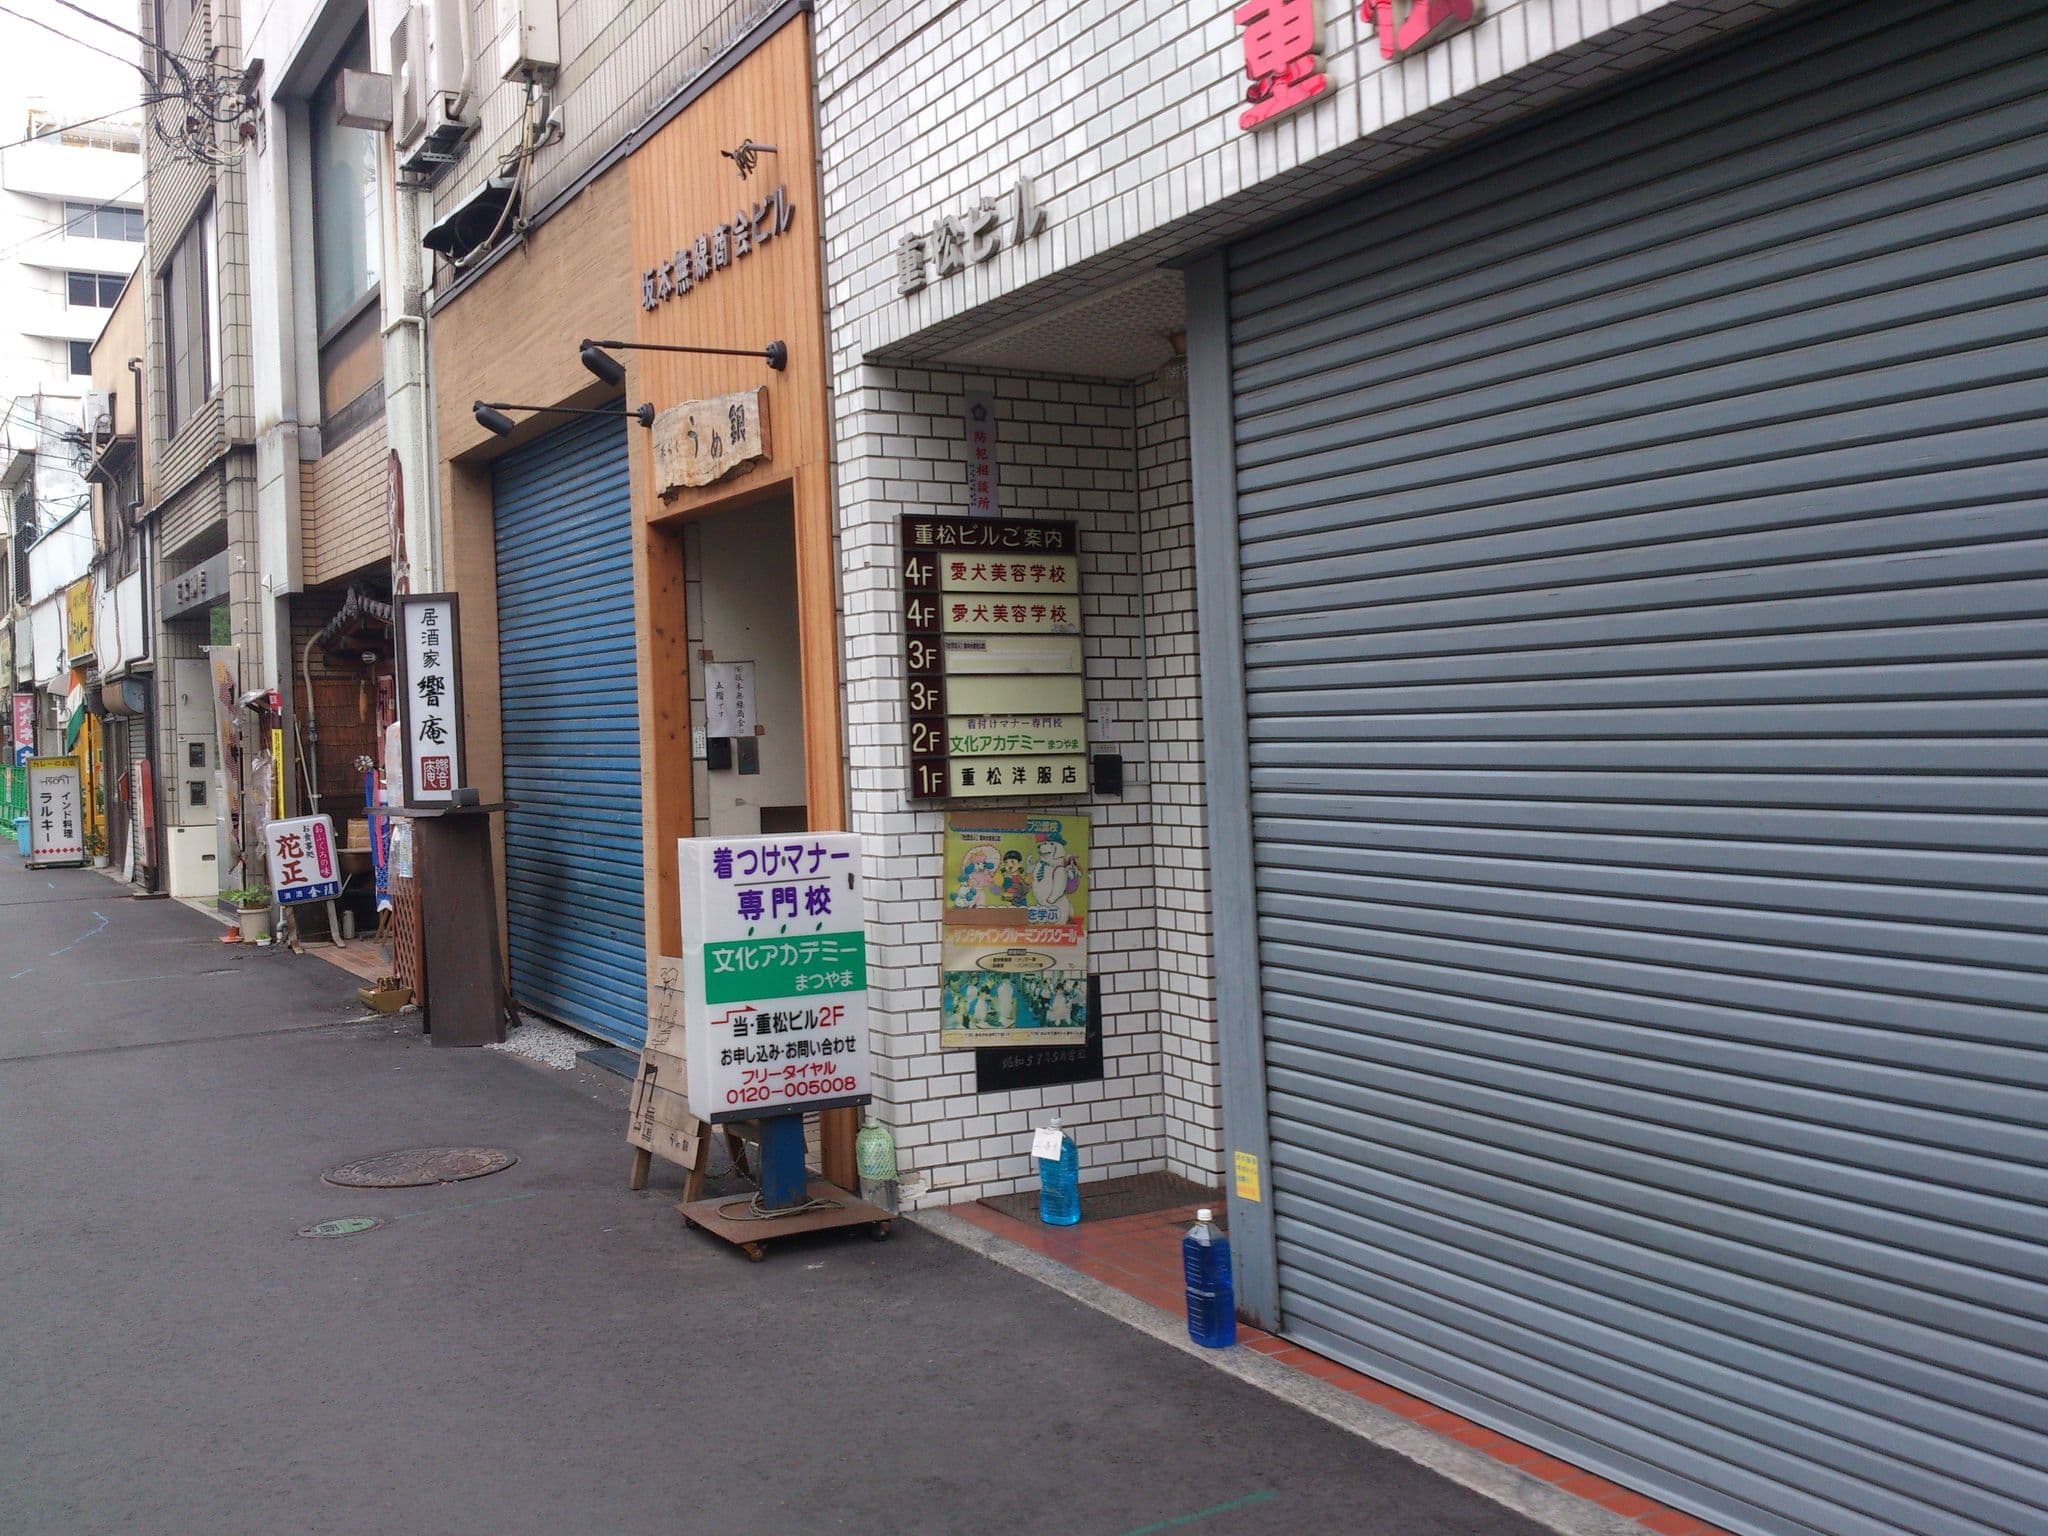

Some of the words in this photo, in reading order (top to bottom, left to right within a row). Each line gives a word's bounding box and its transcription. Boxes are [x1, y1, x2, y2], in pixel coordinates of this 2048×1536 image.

[641, 183, 795, 312] 坂本無線商会ビル
[896, 175, 1048, 296] 重松ビル
[913, 523, 1064, 548] 重松ビルご案内
[904, 557, 934, 587] 4F
[950, 562, 1066, 584] 愛犬美容学校
[906, 599, 936, 628] 4F
[951, 603, 1067, 625] 愛犬美容学校
[908, 640, 938, 670] 3F
[909, 682, 939, 711] 3F
[911, 723, 941, 753] 2F
[966, 717, 1064, 730] 着付けマナー専門校
[949, 734, 1045, 753] 文化アカデミー
[1047, 738, 1080, 750] まつやま
[917, 764, 944, 795] 1F
[960, 765, 1077, 787] 重松洋服店
[39, 792, 55, 843] ラルキー
[61, 791, 74, 839] インド料理
[275, 833, 309, 887] 花正
[315, 824, 332, 878] おふくろの味
[713, 842, 850, 880] 着つけマナー
[737, 885, 832, 921] 専門校
[712, 940, 858, 974] 文化アカデミー
[795, 970, 854, 992] まつやま
[720, 1035, 857, 1067] お申し込み・お問い合わせ
[726, 1076, 857, 1105] 0120-005008
